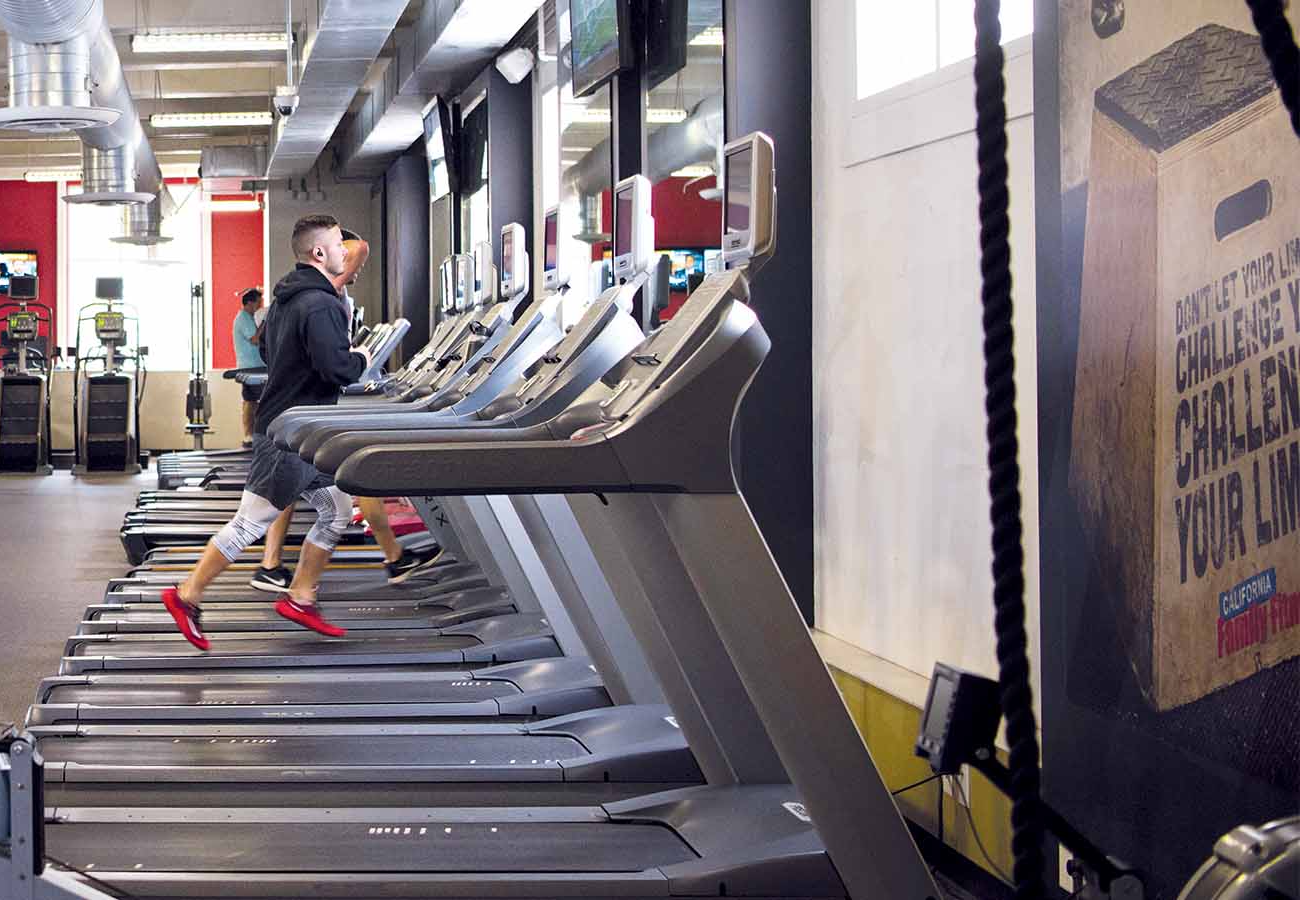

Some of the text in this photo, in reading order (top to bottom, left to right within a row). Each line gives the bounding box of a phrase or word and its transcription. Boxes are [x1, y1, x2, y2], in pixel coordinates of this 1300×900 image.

[1175, 284, 1212, 336] DON'T
[1215, 270, 1238, 313] LET
[1242, 252, 1276, 299] YOUR
[1175, 287, 1285, 394] CHALLENGE
[1175, 345, 1300, 489] CHALLEN
[1174, 471, 1247, 585] YOUR
[1222, 573, 1273, 616] CALIFORNIA
